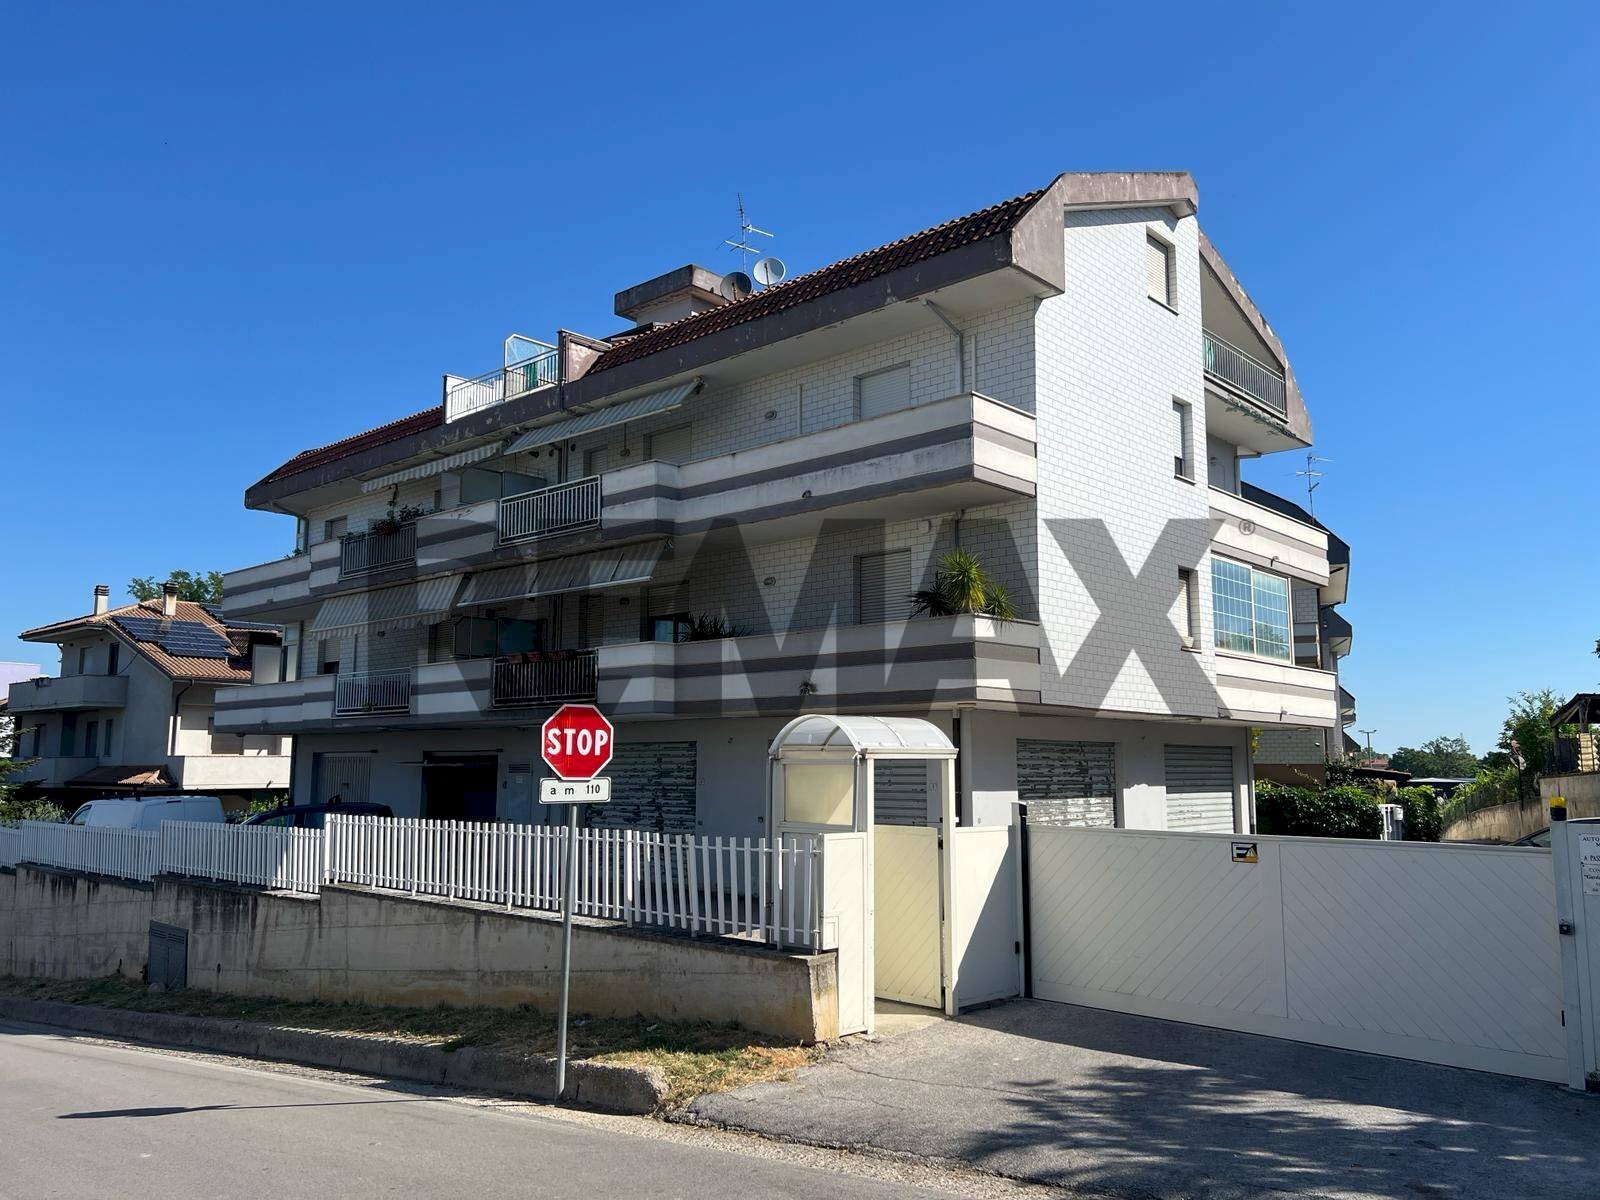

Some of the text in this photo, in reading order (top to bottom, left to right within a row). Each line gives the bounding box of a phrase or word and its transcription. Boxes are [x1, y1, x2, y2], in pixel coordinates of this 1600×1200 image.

[547, 727, 608, 756] STOP
[550, 784, 601, 795] a m 110
